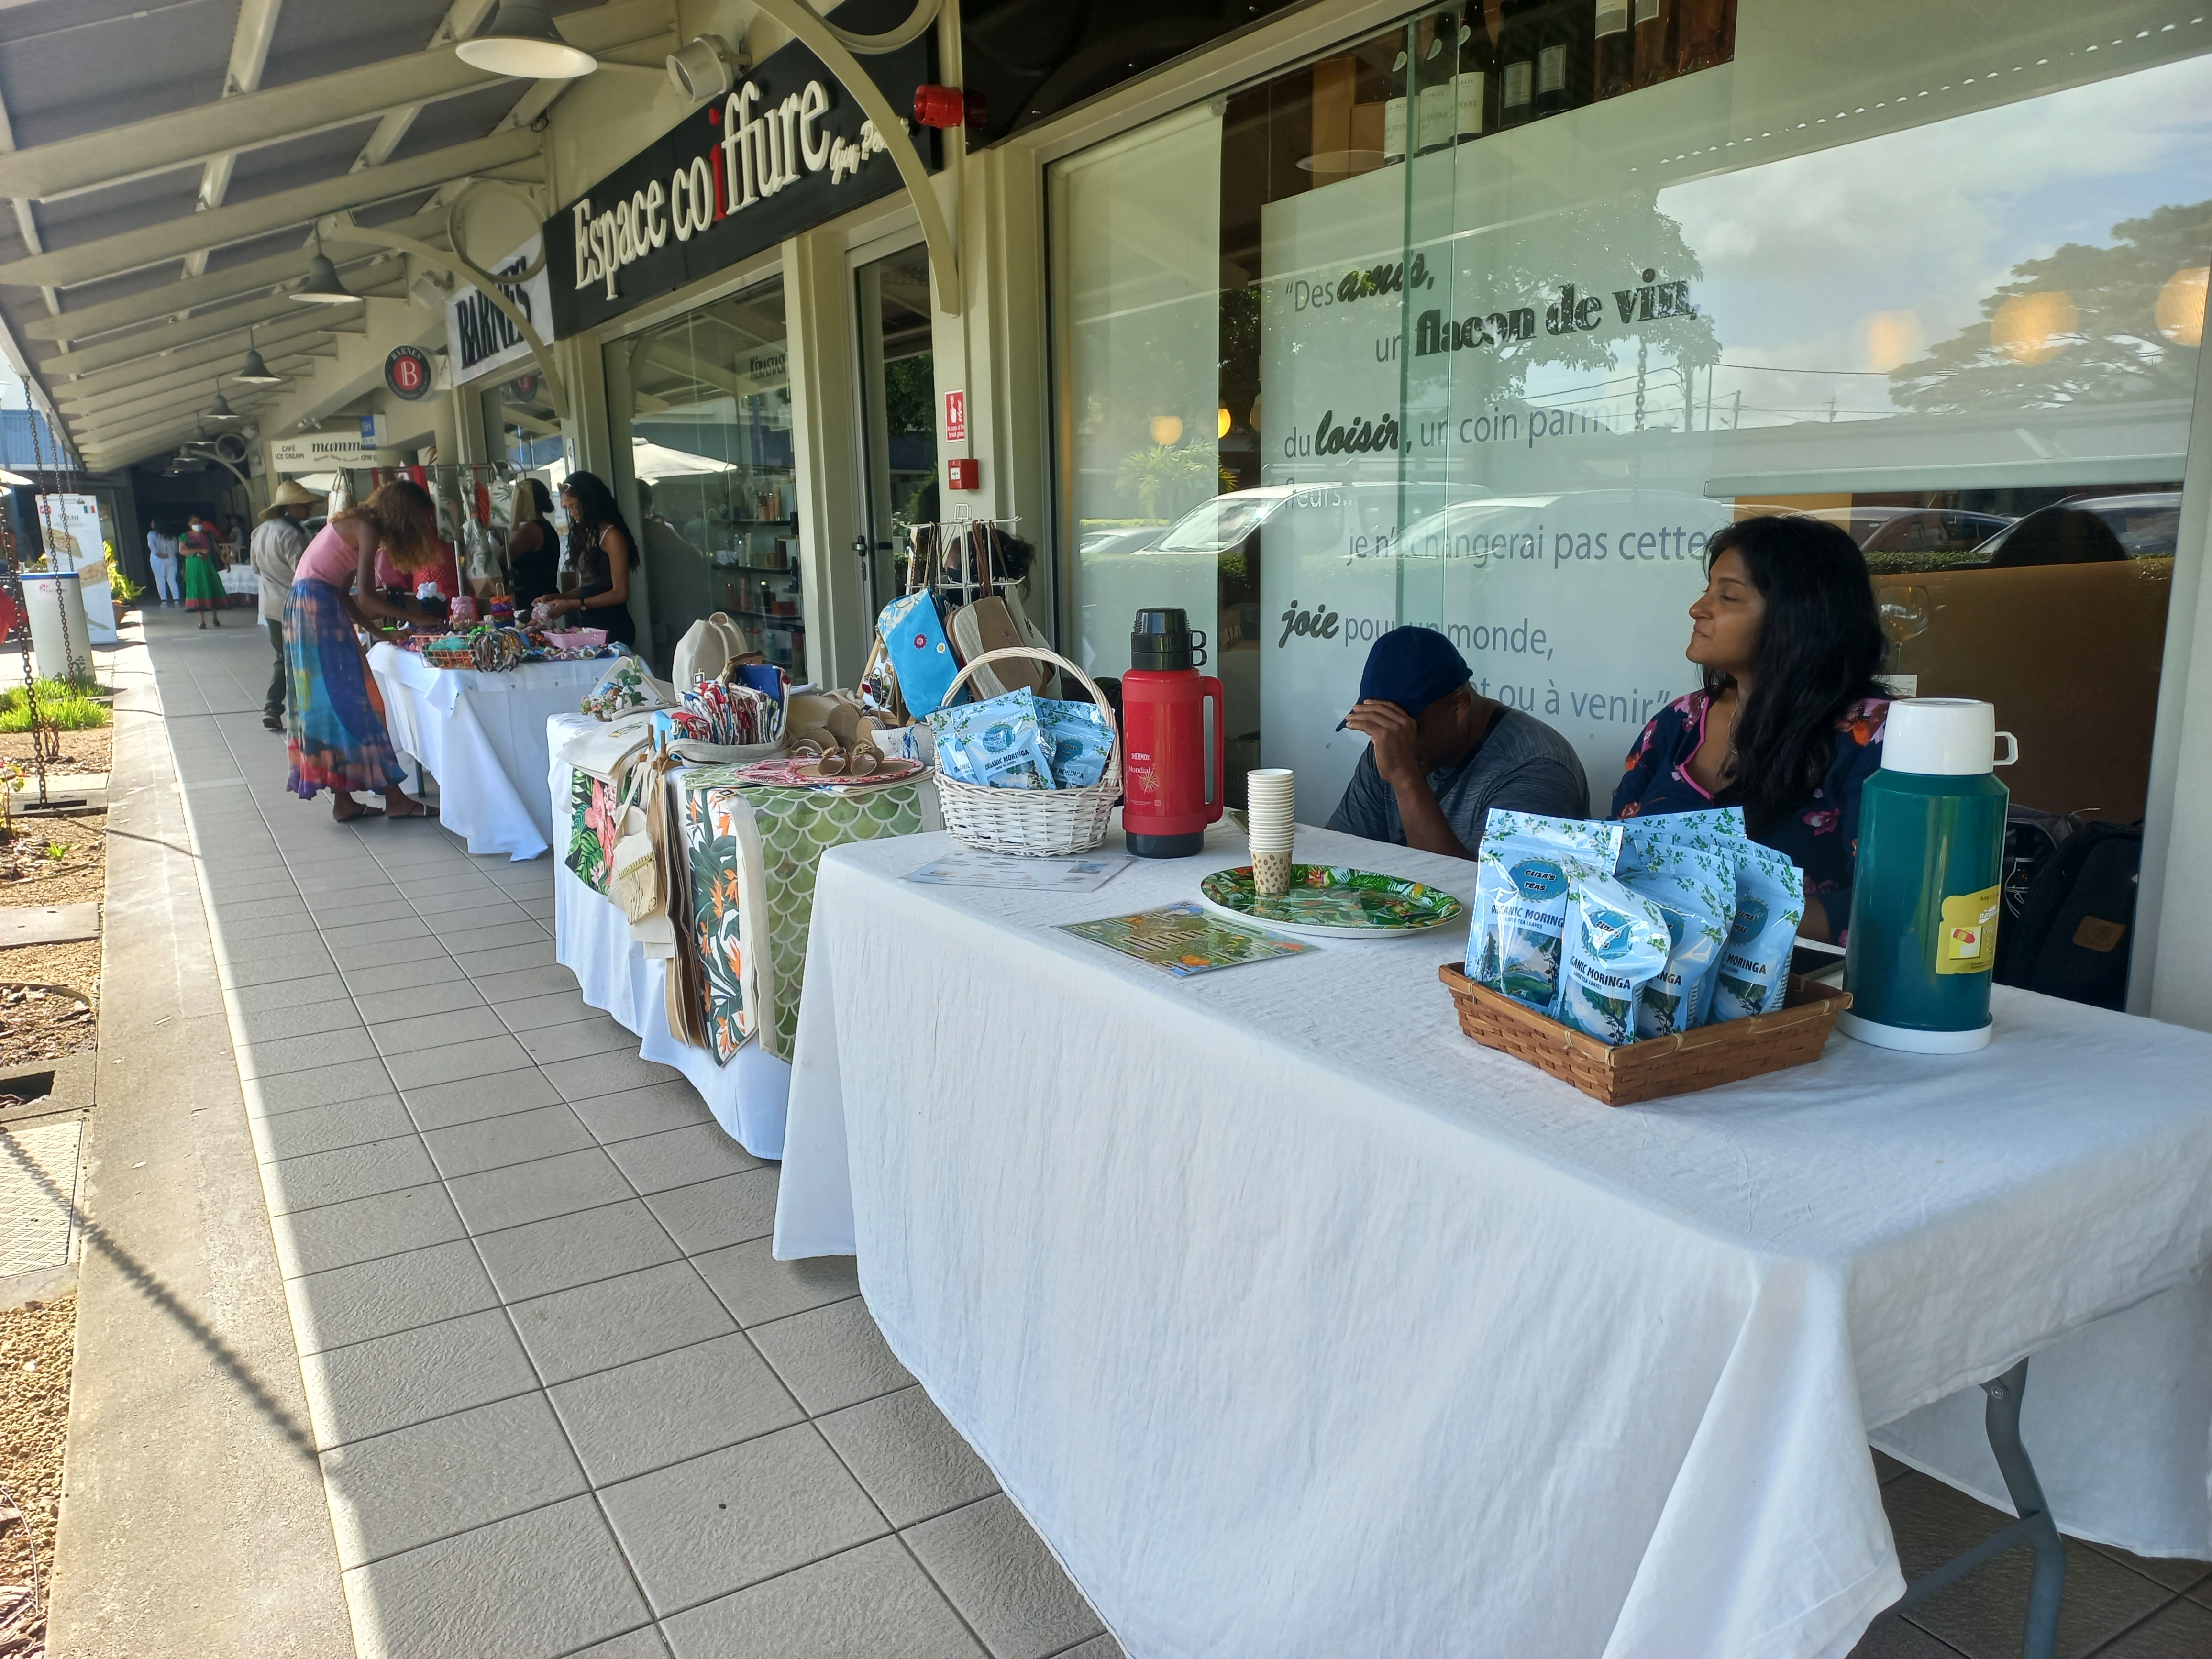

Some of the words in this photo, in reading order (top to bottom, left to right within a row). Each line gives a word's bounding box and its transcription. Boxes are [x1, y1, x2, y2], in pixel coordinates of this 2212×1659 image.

[572, 179, 667, 300] Espace
[672, 80, 830, 242] coiffure
[1414, 309, 1537, 357] flacon
[1546, 282, 1603, 337] de
[391, 347, 421, 360] BARNES
[400, 361, 418, 387] B
[1284, 426, 1310, 458] du
[1460, 406, 1517, 444] coin
[311, 442, 365, 452] mamm
[1346, 528, 1368, 566] je
[1554, 529, 1607, 569] pas
[1619, 526, 1704, 561] cette
[1278, 600, 1339, 648] joie
[1345, 617, 1395, 647] pou
[1448, 618, 1553, 661] monde,
[1499, 684, 1534, 712] ou
[1545, 679, 1559, 715] à
[984, 756, 1003, 770] ORGANIC
[1004, 749, 1029, 763] MORINGA
[1128, 764, 1150, 774] Mondial
[1058, 768, 1084, 780] MORINGA
[1525, 869, 1557, 881] ELIZA'S
[1524, 881, 1547, 891] TEAS
[1525, 909, 1564, 928] MORING
[1726, 953, 1767, 975] MORINGA
[1726, 965, 1739, 974] LEAVES
[1574, 970, 1582, 980] LOOSE
[1589, 980, 1602, 990] LEAVES
[1588, 967, 1631, 990] MORINGA
